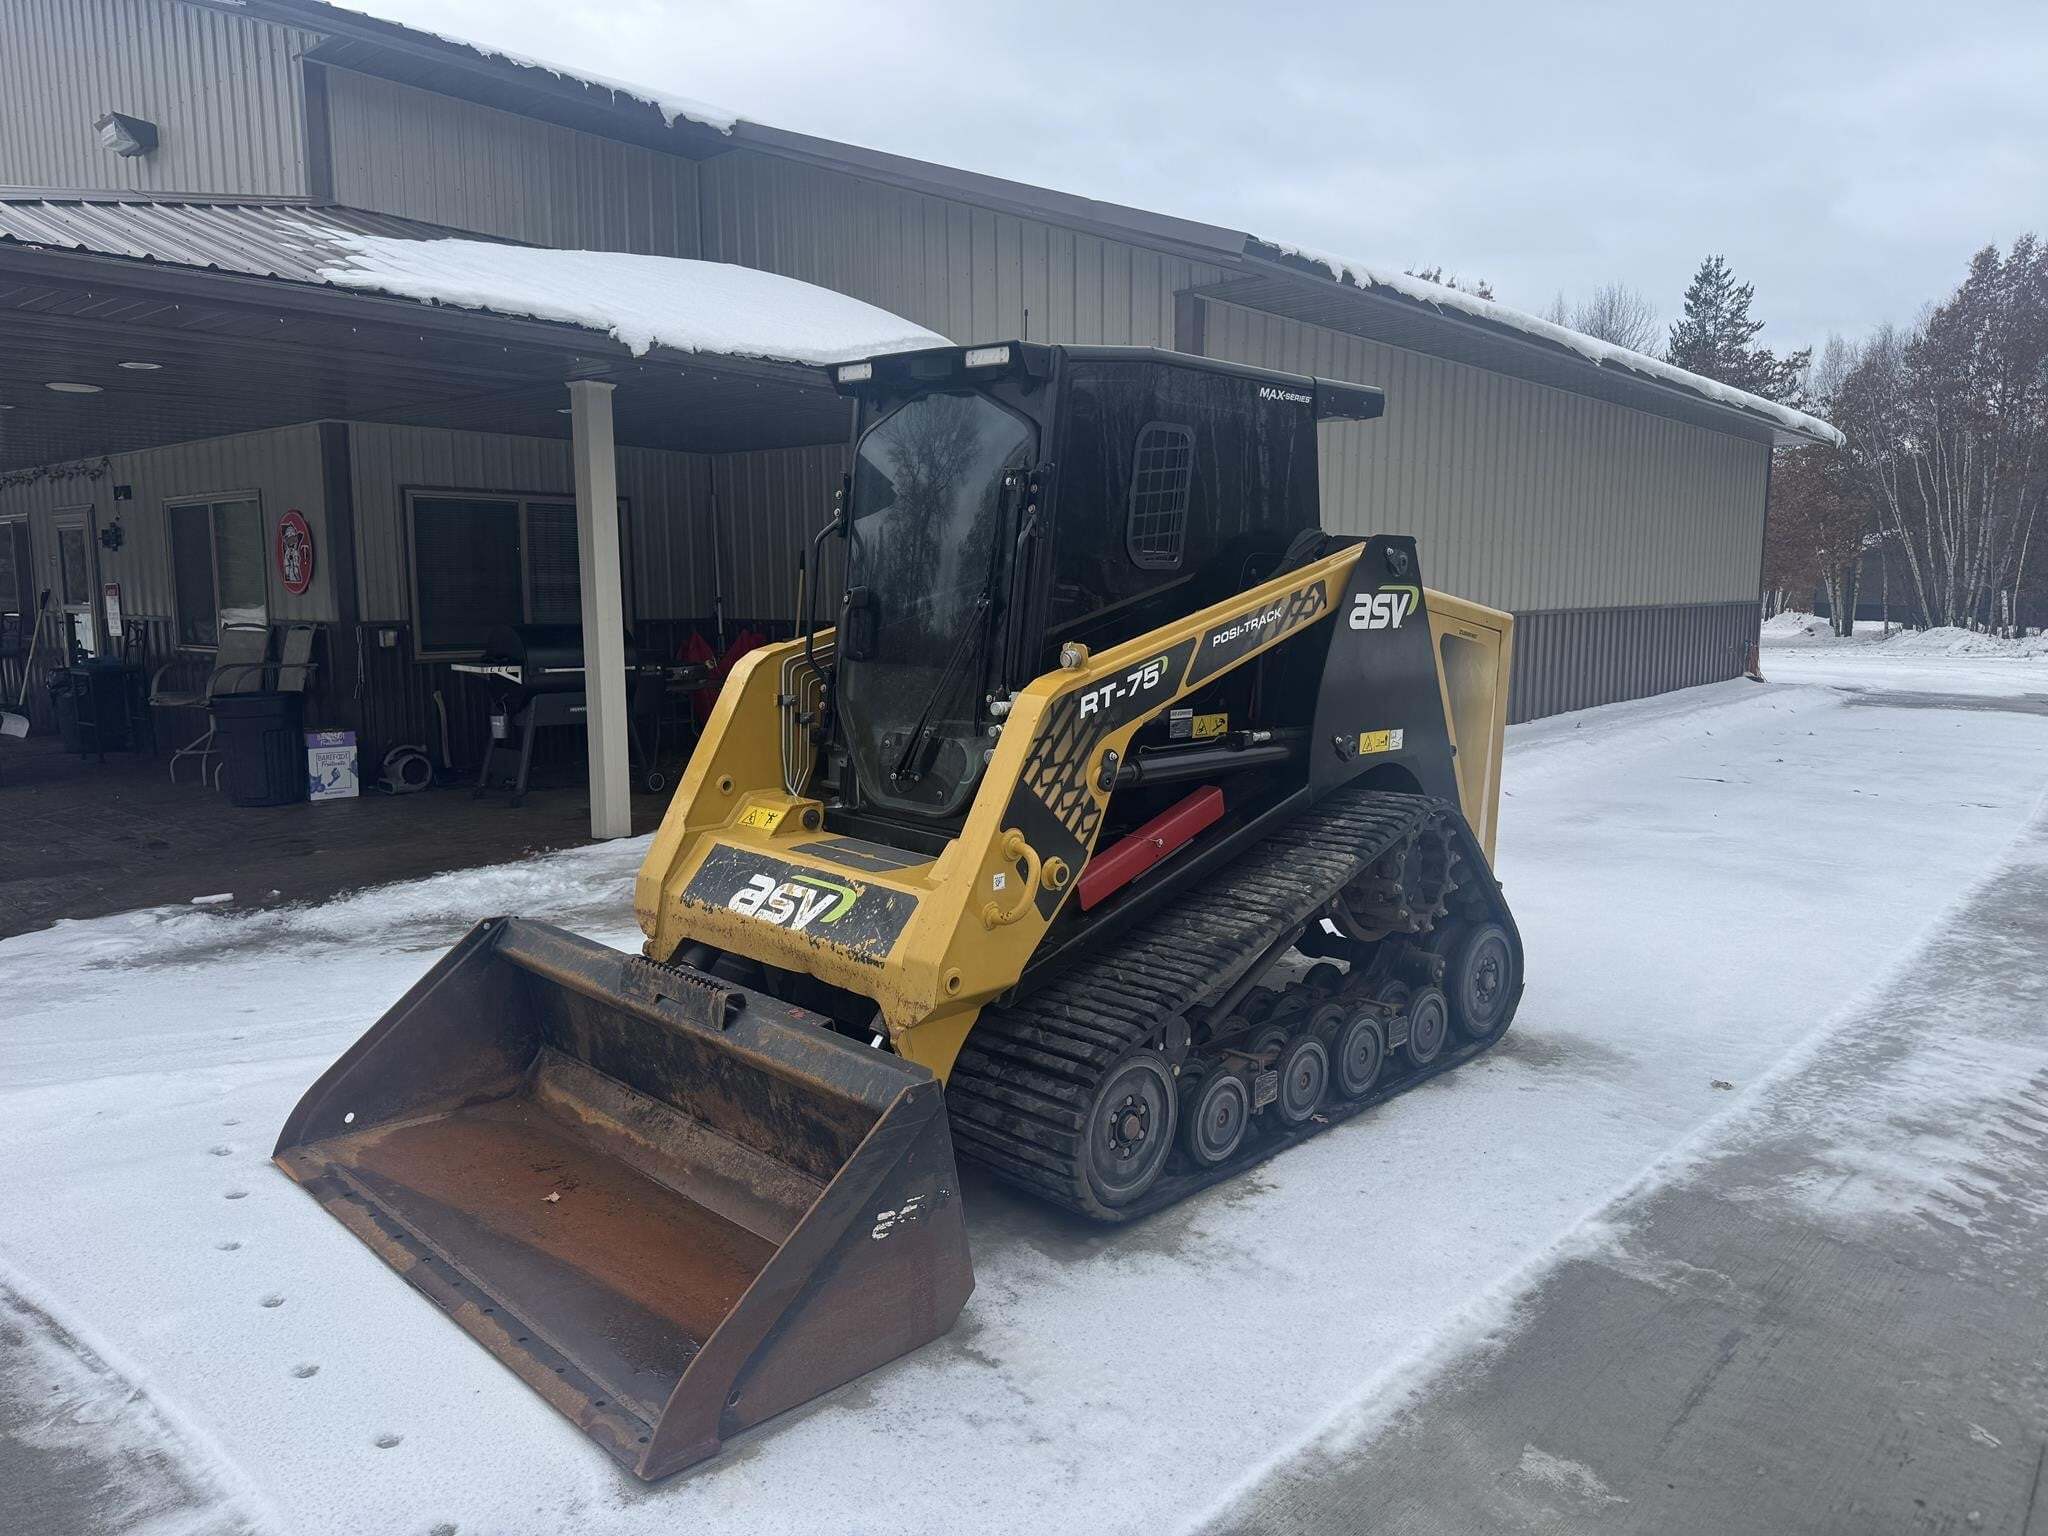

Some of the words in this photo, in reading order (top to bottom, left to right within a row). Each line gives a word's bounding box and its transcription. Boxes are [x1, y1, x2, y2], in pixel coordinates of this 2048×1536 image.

[1212, 607, 1282, 647] POSI-TRACK
[1350, 593, 1410, 629] asv
[1080, 663, 1160, 719] RT-75
[728, 874, 839, 930] asv
